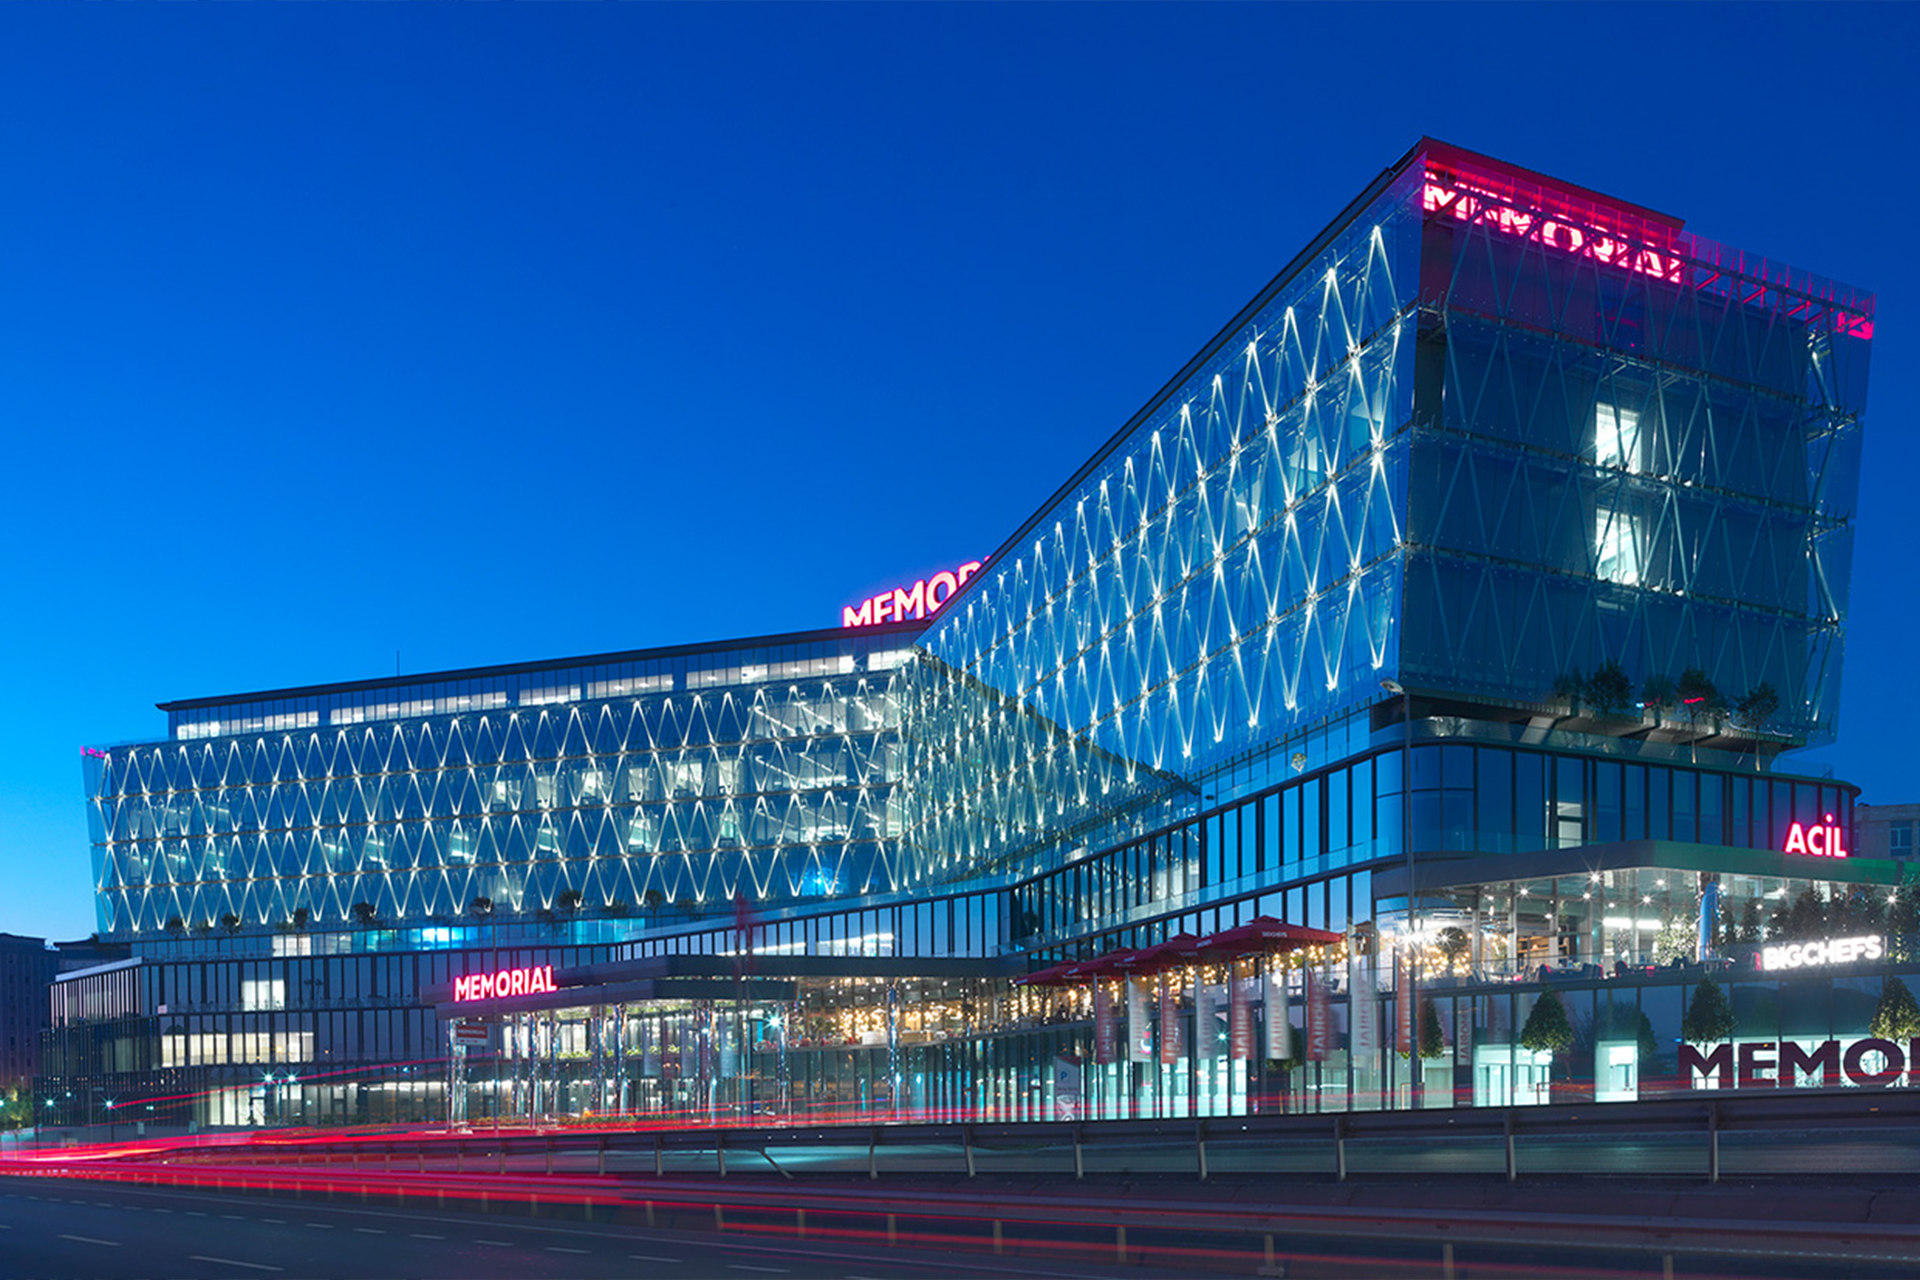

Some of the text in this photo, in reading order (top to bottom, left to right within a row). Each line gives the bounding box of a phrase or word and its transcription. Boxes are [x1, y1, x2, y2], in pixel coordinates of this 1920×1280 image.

[1762, 935, 1882, 971] BIGCHEFS
[454, 965, 558, 1003] MEMORIAL
[1679, 1037, 1920, 1091] MEMO
